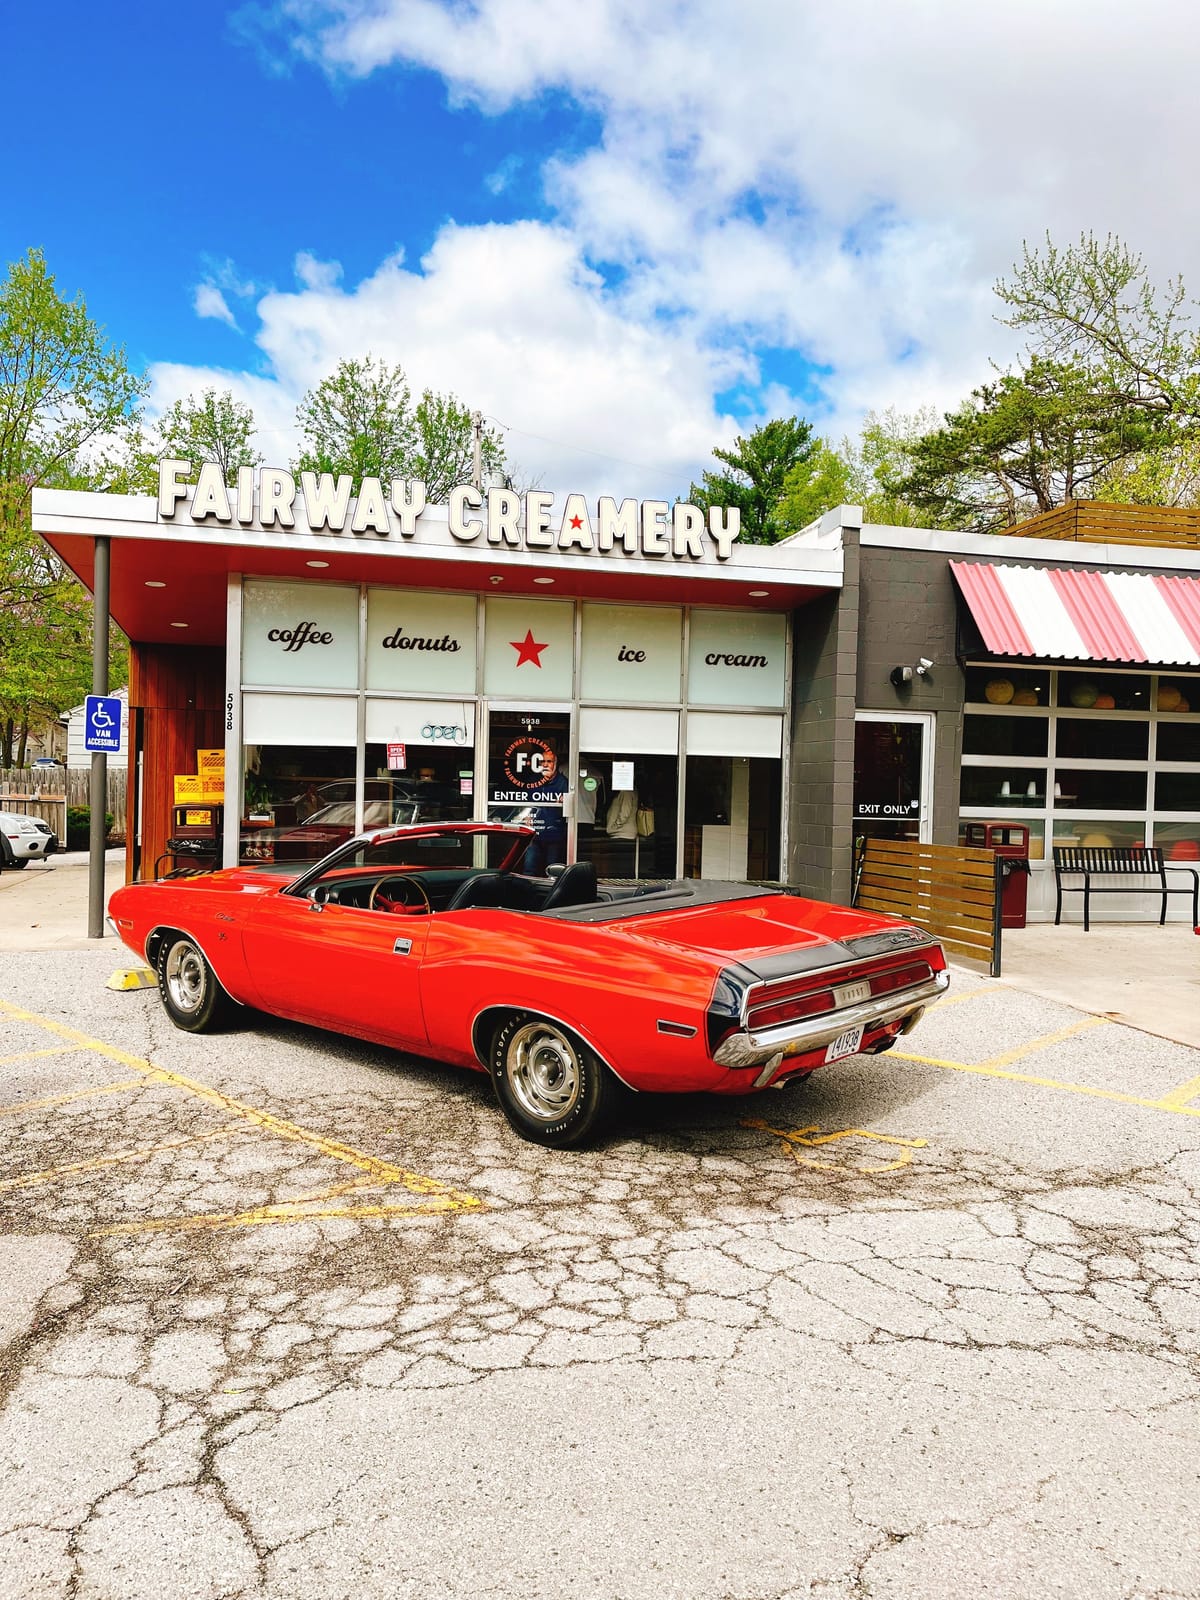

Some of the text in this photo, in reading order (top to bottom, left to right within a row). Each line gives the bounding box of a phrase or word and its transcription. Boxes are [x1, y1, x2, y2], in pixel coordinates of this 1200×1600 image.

[159, 458, 741, 558] FAIRWAY CREAMERY
[268, 621, 333, 652] coffee
[382, 627, 461, 652] donuts
[617, 645, 768, 668] ice cream
[226, 692, 234, 731] 5938
[87, 738, 119, 747] ACCESSIBLE
[96, 729, 111, 738] VAN
[421, 725, 464, 742] open
[504, 736, 527, 758] FAIRWAY
[504, 767, 525, 788] FAIRWAY
[494, 791, 561, 802] ENTER ONLY
[859, 804, 910, 815] EXIT ONLY
